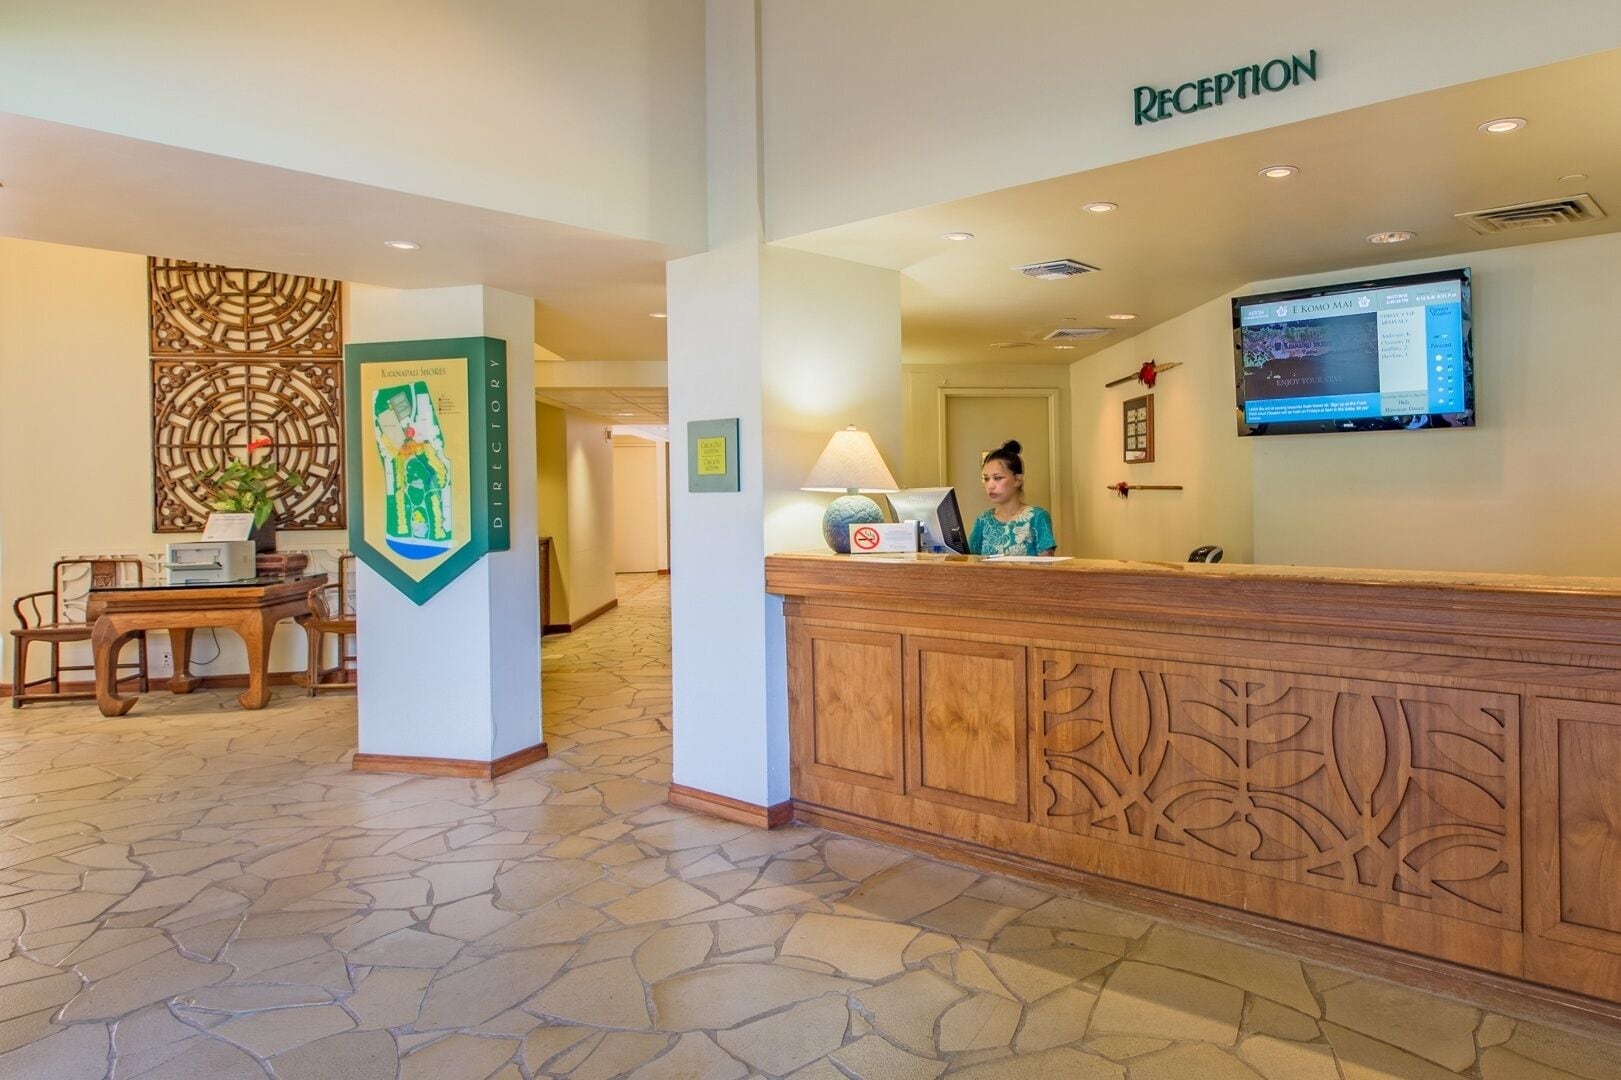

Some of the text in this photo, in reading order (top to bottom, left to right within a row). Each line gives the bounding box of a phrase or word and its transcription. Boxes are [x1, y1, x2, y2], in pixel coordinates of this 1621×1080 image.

[1133, 49, 1317, 126] RECEPTION
[1293, 300, 1353, 314] E KOMO MAI
[420, 366, 446, 376] SHORES
[1276, 376, 1300, 387] ENJOY
[1301, 375, 1323, 385] YOUR
[490, 359, 503, 528] DIRECTORY
